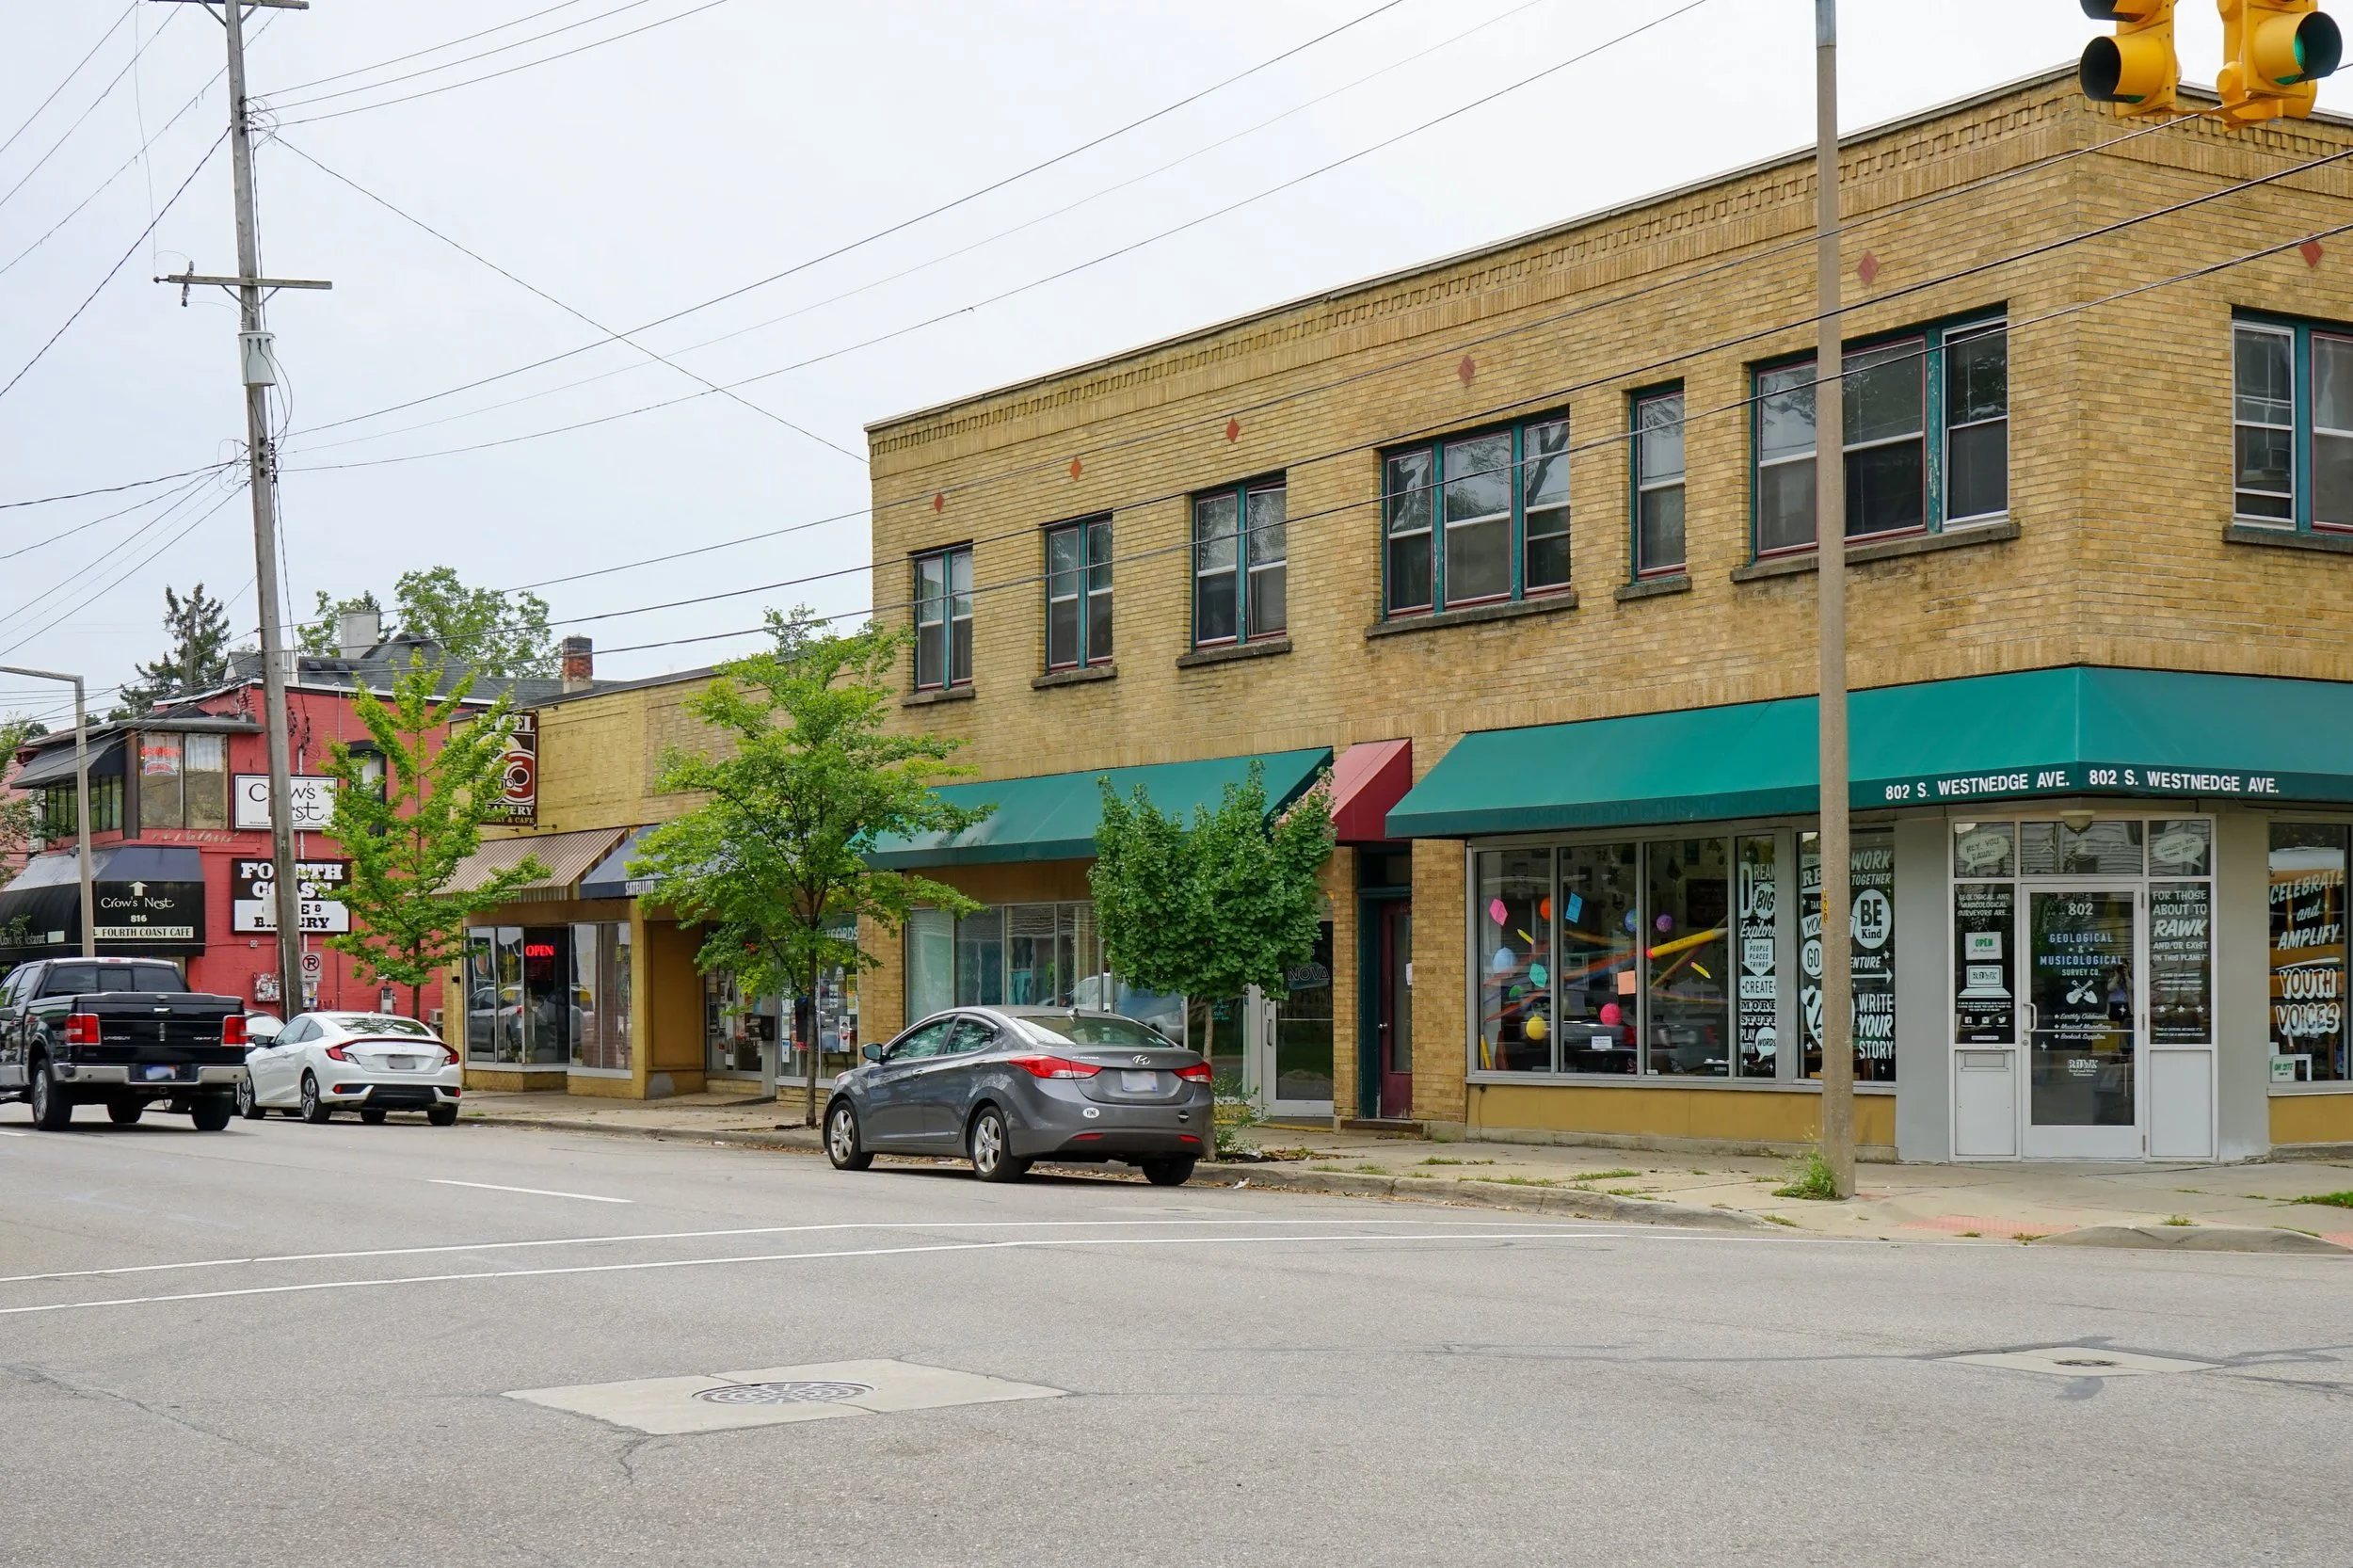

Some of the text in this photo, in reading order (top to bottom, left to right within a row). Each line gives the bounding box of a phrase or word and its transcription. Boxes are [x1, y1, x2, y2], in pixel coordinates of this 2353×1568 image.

[1885, 771, 2070, 800] 802 S. WESTNEDGE AVE.
[2089, 770, 2280, 793] 802 S. WESTNEDGE AVE.
[1851, 850, 1892, 871] WORK
[241, 863, 343, 880] FORTH
[1851, 873, 1892, 886] TOGETHER
[2269, 868, 2345, 904] CELEBRATE
[1755, 889, 1775, 911] BIG
[2153, 889, 2207, 901] FOR THOSE
[100, 897, 175, 909] Crow's Nest
[2068, 903, 2093, 916] 802
[2153, 904, 2207, 915] ABOUT TO
[2297, 898, 2321, 921] and
[1861, 899, 1882, 926] BE
[103, 926, 191, 937] FOURTH COAST CAFE
[1862, 929, 1881, 939] Kind
[2153, 919, 2207, 937] RAWK
[2049, 934, 2113, 943] GEOLOGICAL
[2277, 923, 2340, 951] AMPLIFY
[525, 944, 554, 957] OPEN
[2153, 941, 2184, 950] AND/OR
[1807, 948, 1819, 968] GO
[1850, 956, 1881, 969] ENTURE
[2041, 955, 2122, 965] MUSICOLOGICAL
[1288, 967, 1330, 981] NOVA
[1745, 981, 1773, 993] CREATE
[2279, 968, 2337, 999] YOUTH
[1859, 994, 1893, 1013] WRITE
[2275, 1002, 2341, 1035] VOICES
[1858, 1015, 1893, 1037] YOUR
[1740, 1029, 1755, 1041] PLAY
[1740, 1042, 1755, 1053] WITH
[1758, 1038, 1776, 1047] WORDS
[1859, 1041, 1893, 1059] STORY
